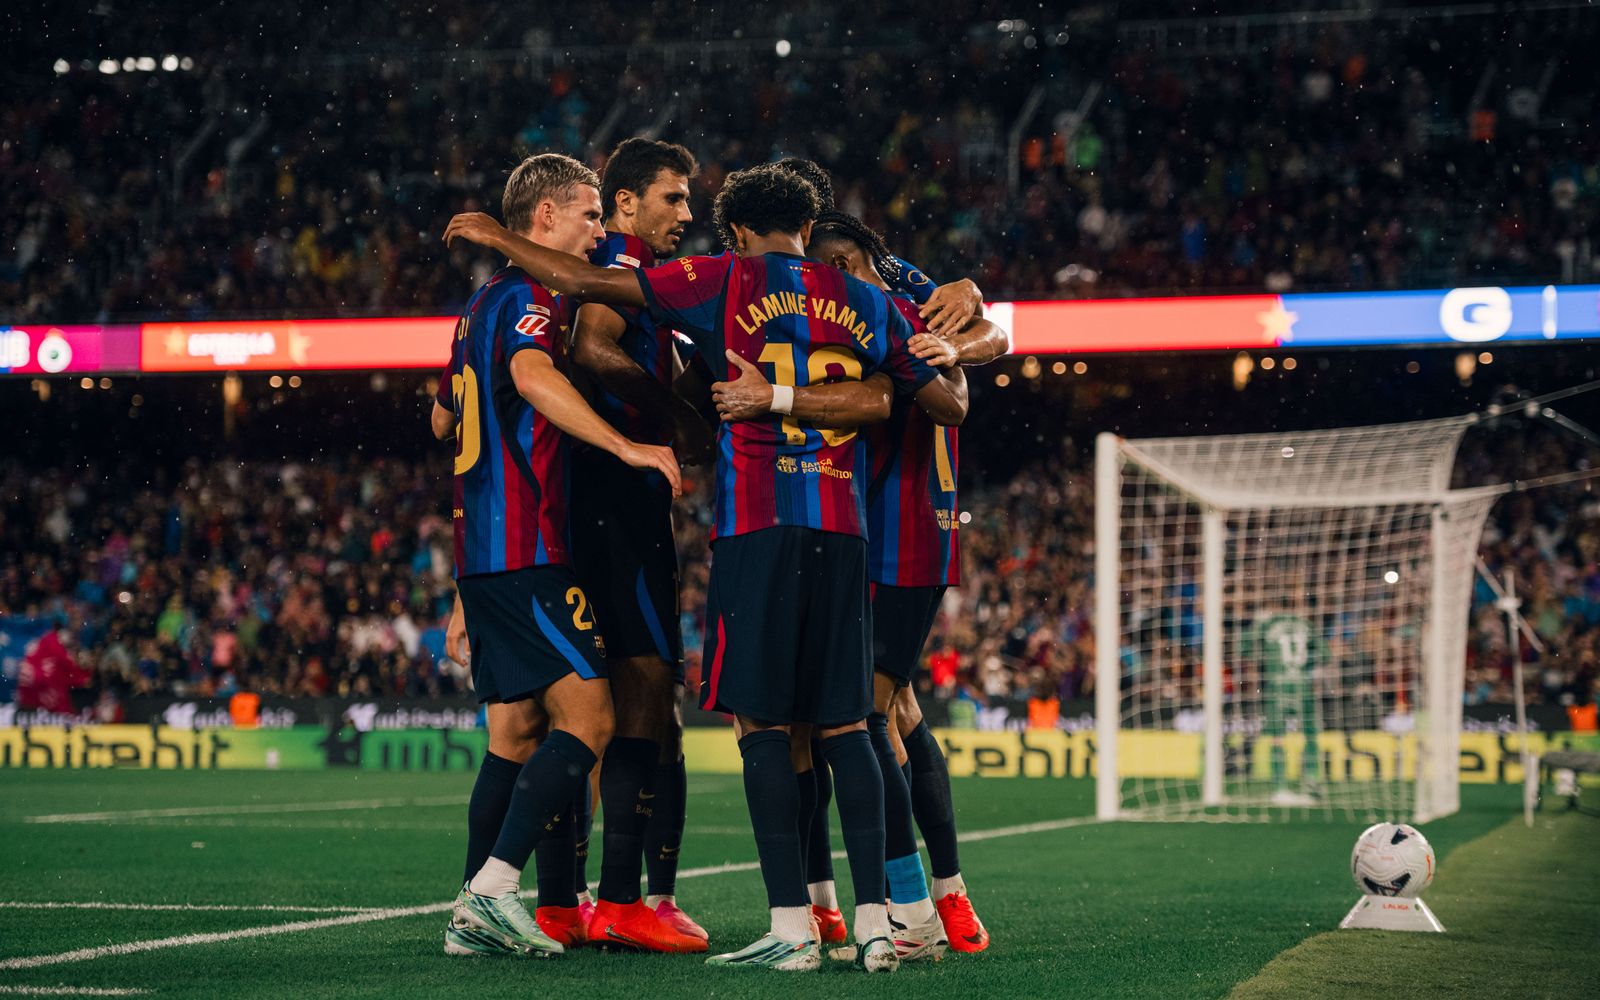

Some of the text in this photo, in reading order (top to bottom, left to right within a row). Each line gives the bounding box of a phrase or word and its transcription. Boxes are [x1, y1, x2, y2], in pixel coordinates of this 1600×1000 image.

[735, 291, 875, 350] LAMINE YAMAL
[1440, 287, 1512, 342] G
